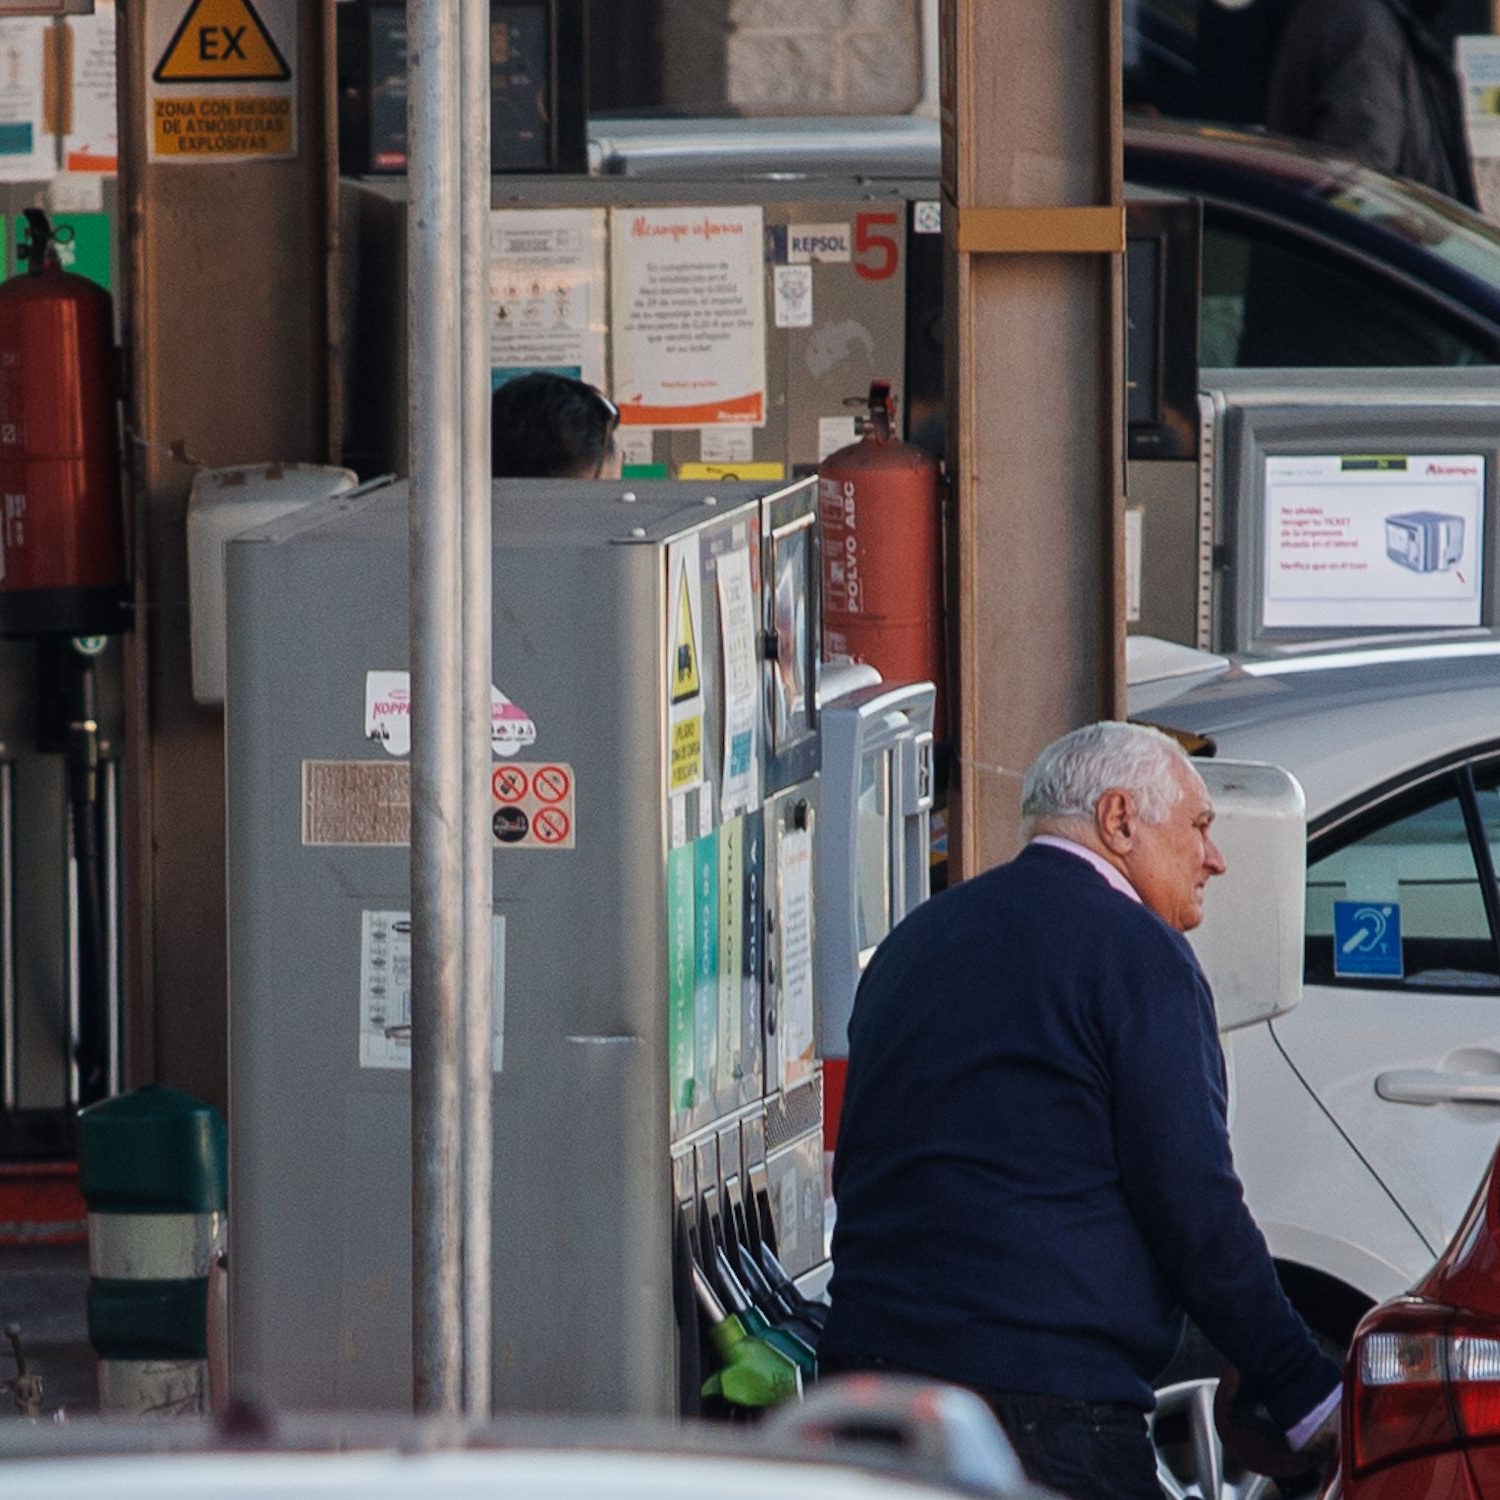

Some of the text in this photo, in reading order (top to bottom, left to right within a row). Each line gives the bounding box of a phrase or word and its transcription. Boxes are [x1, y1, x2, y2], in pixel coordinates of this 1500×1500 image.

[199, 27, 246, 60] EX
[156, 100, 290, 117] ZONA CON RIESGO
[163, 119, 181, 134] DE
[179, 135, 268, 151] EXPLOSIVAS
[792, 236, 847, 252] REPSOL
[855, 211, 899, 281] 5
[1426, 463, 1478, 476] Alcampo
[844, 480, 859, 614] POLVO ABC
[675, 908, 684, 1031] PLOMO
[702, 906, 710, 1014] PLOMO
[748, 840, 757, 1049] GASOLEO A
[725, 937, 733, 1075] GASOLEO
